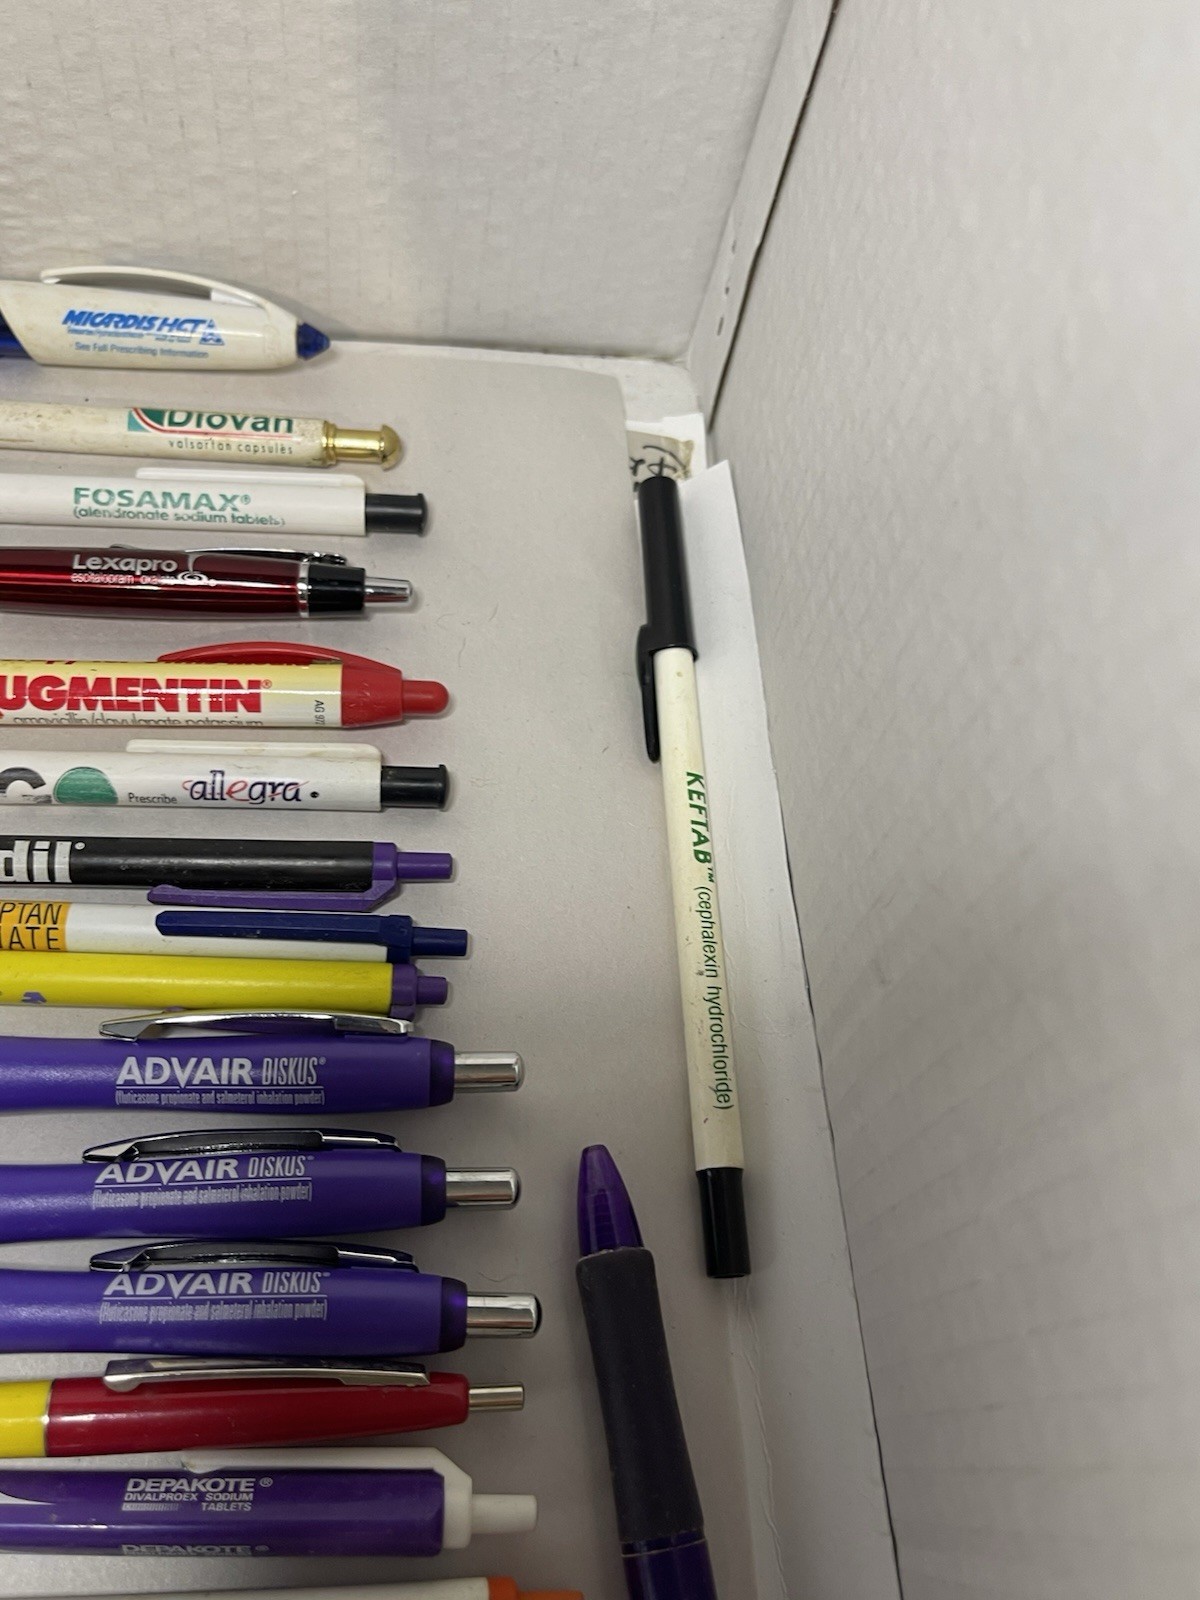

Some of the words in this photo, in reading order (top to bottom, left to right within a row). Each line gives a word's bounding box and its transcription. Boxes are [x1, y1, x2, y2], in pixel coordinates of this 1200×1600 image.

[62, 310, 159, 331] MICARDIS
[156, 317, 208, 333] HCT
[169, 438, 231, 451] valsartan
[237, 441, 293, 455] capsules
[174, 511, 227, 524] sodium
[72, 554, 178, 575] Lexapro
[128, 792, 178, 804] Prescribe
[184, 770, 305, 804] allegra
[694, 886, 721, 979] (cephalexin
[703, 986, 735, 1110] hydrochloride)
[116, 1056, 253, 1088] ADVAIR
[95, 1157, 239, 1185] ADVAIR
[103, 1272, 253, 1299] ADVAIR
[124, 1493, 199, 1501] DIVALPROEX
[204, 1493, 253, 1501] SODIUM
[201, 1502, 252, 1512] TABLETS
